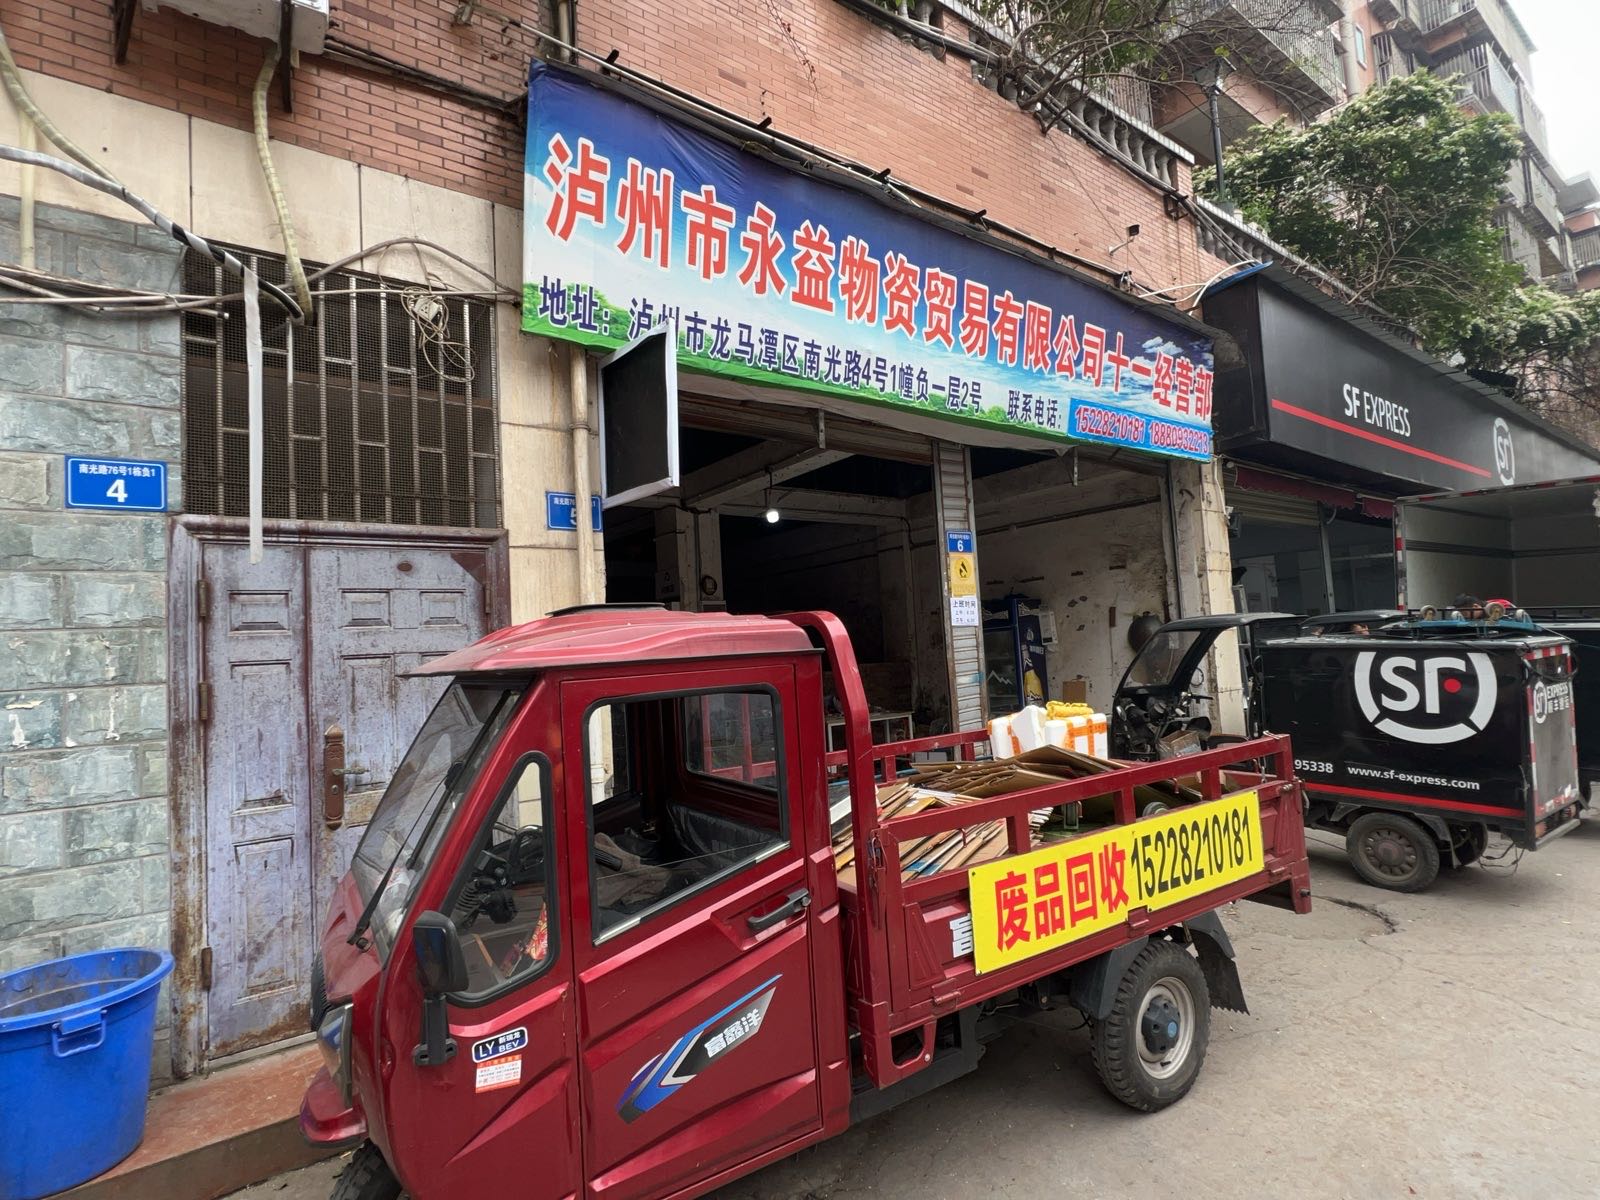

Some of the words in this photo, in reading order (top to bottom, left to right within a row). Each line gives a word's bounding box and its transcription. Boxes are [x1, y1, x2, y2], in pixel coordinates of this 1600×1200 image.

[545, 134, 1213, 422] 泸州市永益物资贸易有限公司十一经营部
[1075, 405, 1145, 443] 15228210181
[1343, 383, 1360, 418] SF
[1363, 391, 1411, 437] EXPRESS
[106, 479, 128, 503] 4
[957, 540, 964, 552] 6
[1294, 759, 1334, 774] 95338
[1347, 765, 1480, 790] www.sf-express.com
[994, 841, 1130, 952] 废品回收
[1131, 805, 1253, 901] 15228210181
[479, 1041, 495, 1058] LY
[498, 1040, 520, 1053] BEV
